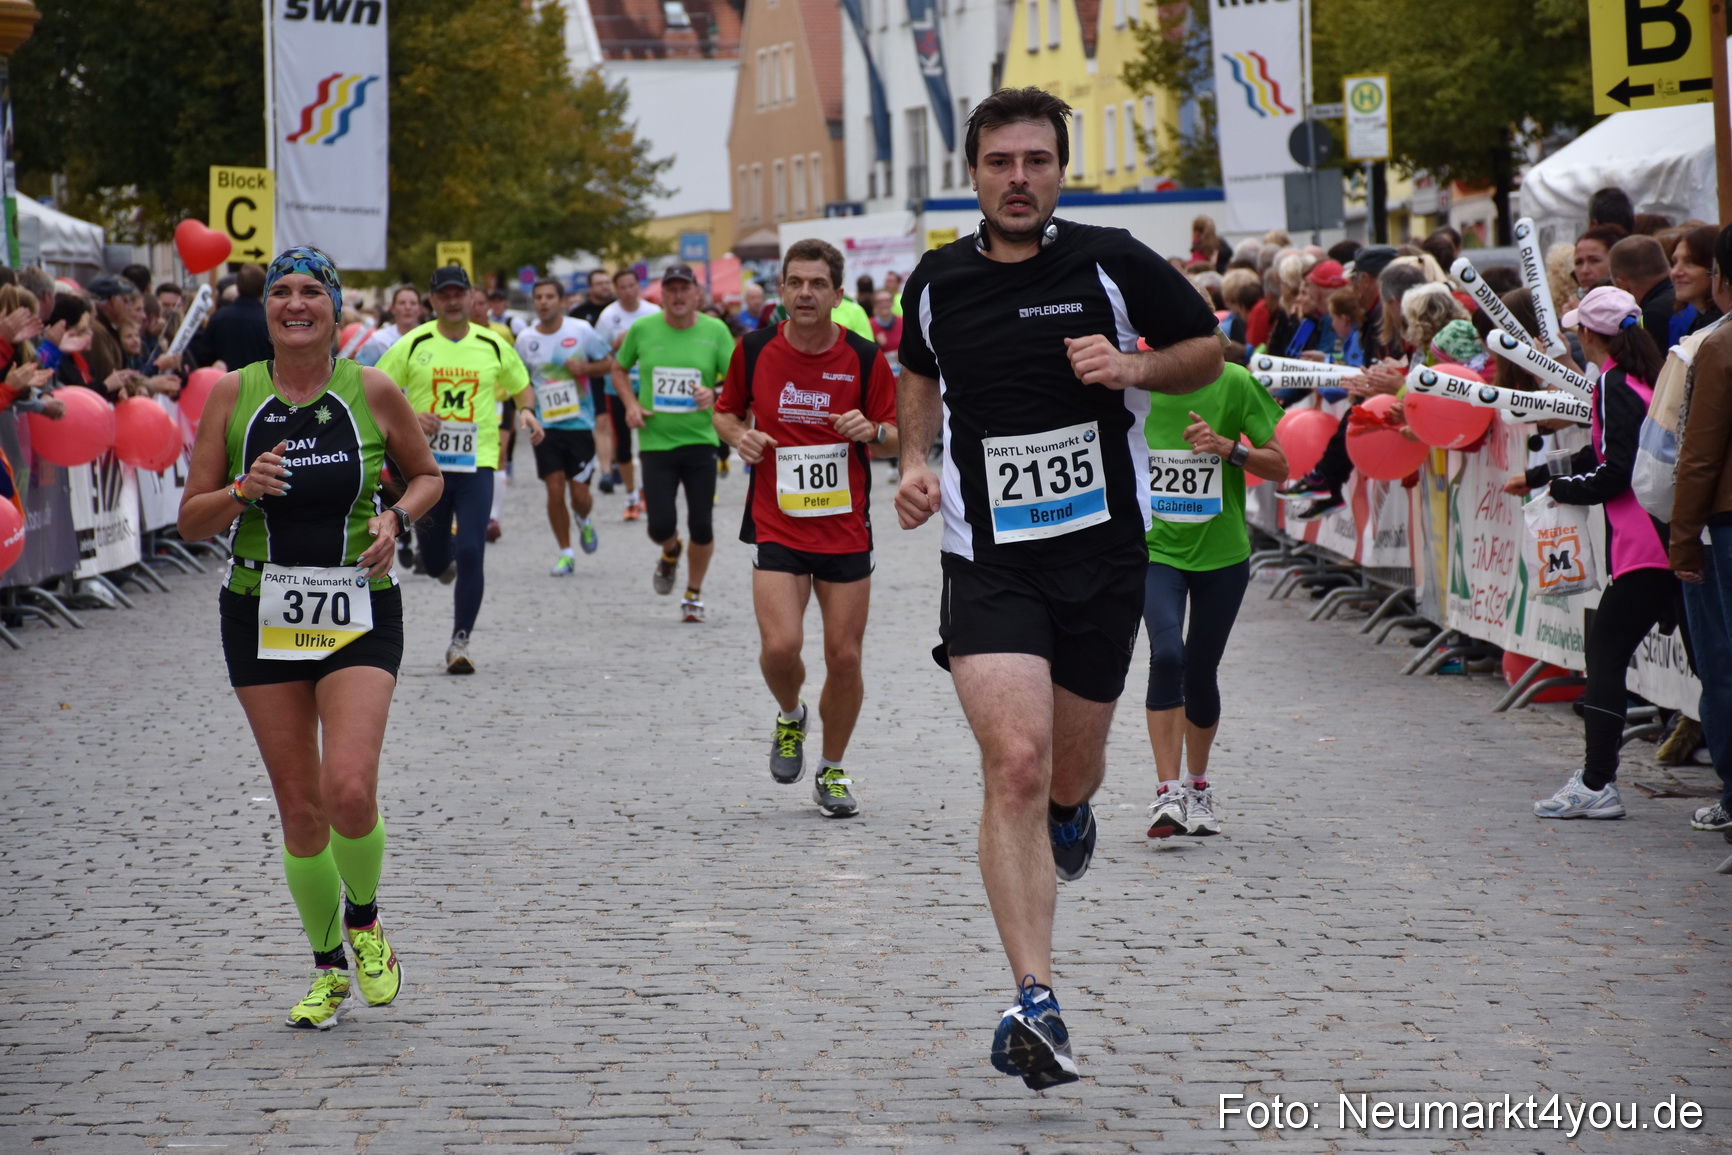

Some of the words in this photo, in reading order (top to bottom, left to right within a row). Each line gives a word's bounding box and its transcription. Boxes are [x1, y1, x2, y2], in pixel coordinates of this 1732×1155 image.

[1624, 0, 1692, 66] B
[217, 171, 267, 189] Block
[225, 196, 257, 241] C
[1475, 283, 1503, 316] BMW
[1520, 246, 1540, 284] BMW
[1531, 283, 1554, 348] Laufsport
[1028, 303, 1083, 317] PFLEIDERER
[432, 367, 480, 378] Müller
[1281, 376, 1314, 387] BMW
[441, 390, 466, 410] M
[545, 390, 571, 408] 104
[286, 437, 317, 451] DAV
[429, 433, 473, 453] 2818
[987, 446, 1024, 457] PARTL
[1025, 436, 1080, 455] Neumarkt
[281, 451, 348, 467] henbach
[778, 454, 803, 462] PARTL
[804, 452, 838, 461] Neumarkt
[793, 462, 838, 490] 180
[998, 448, 1094, 501] 2135
[1149, 465, 1214, 494] 2287
[803, 497, 830, 507] Peter
[1157, 499, 1203, 512] Gabriele
[1030, 502, 1073, 524] Bernd
[1537, 526, 1577, 539] Müller
[1548, 550, 1572, 573] M
[264, 573, 300, 585] PARTL
[302, 576, 352, 587] Neumarkt
[282, 590, 351, 626] 370
[295, 633, 336, 648] Ulrike
